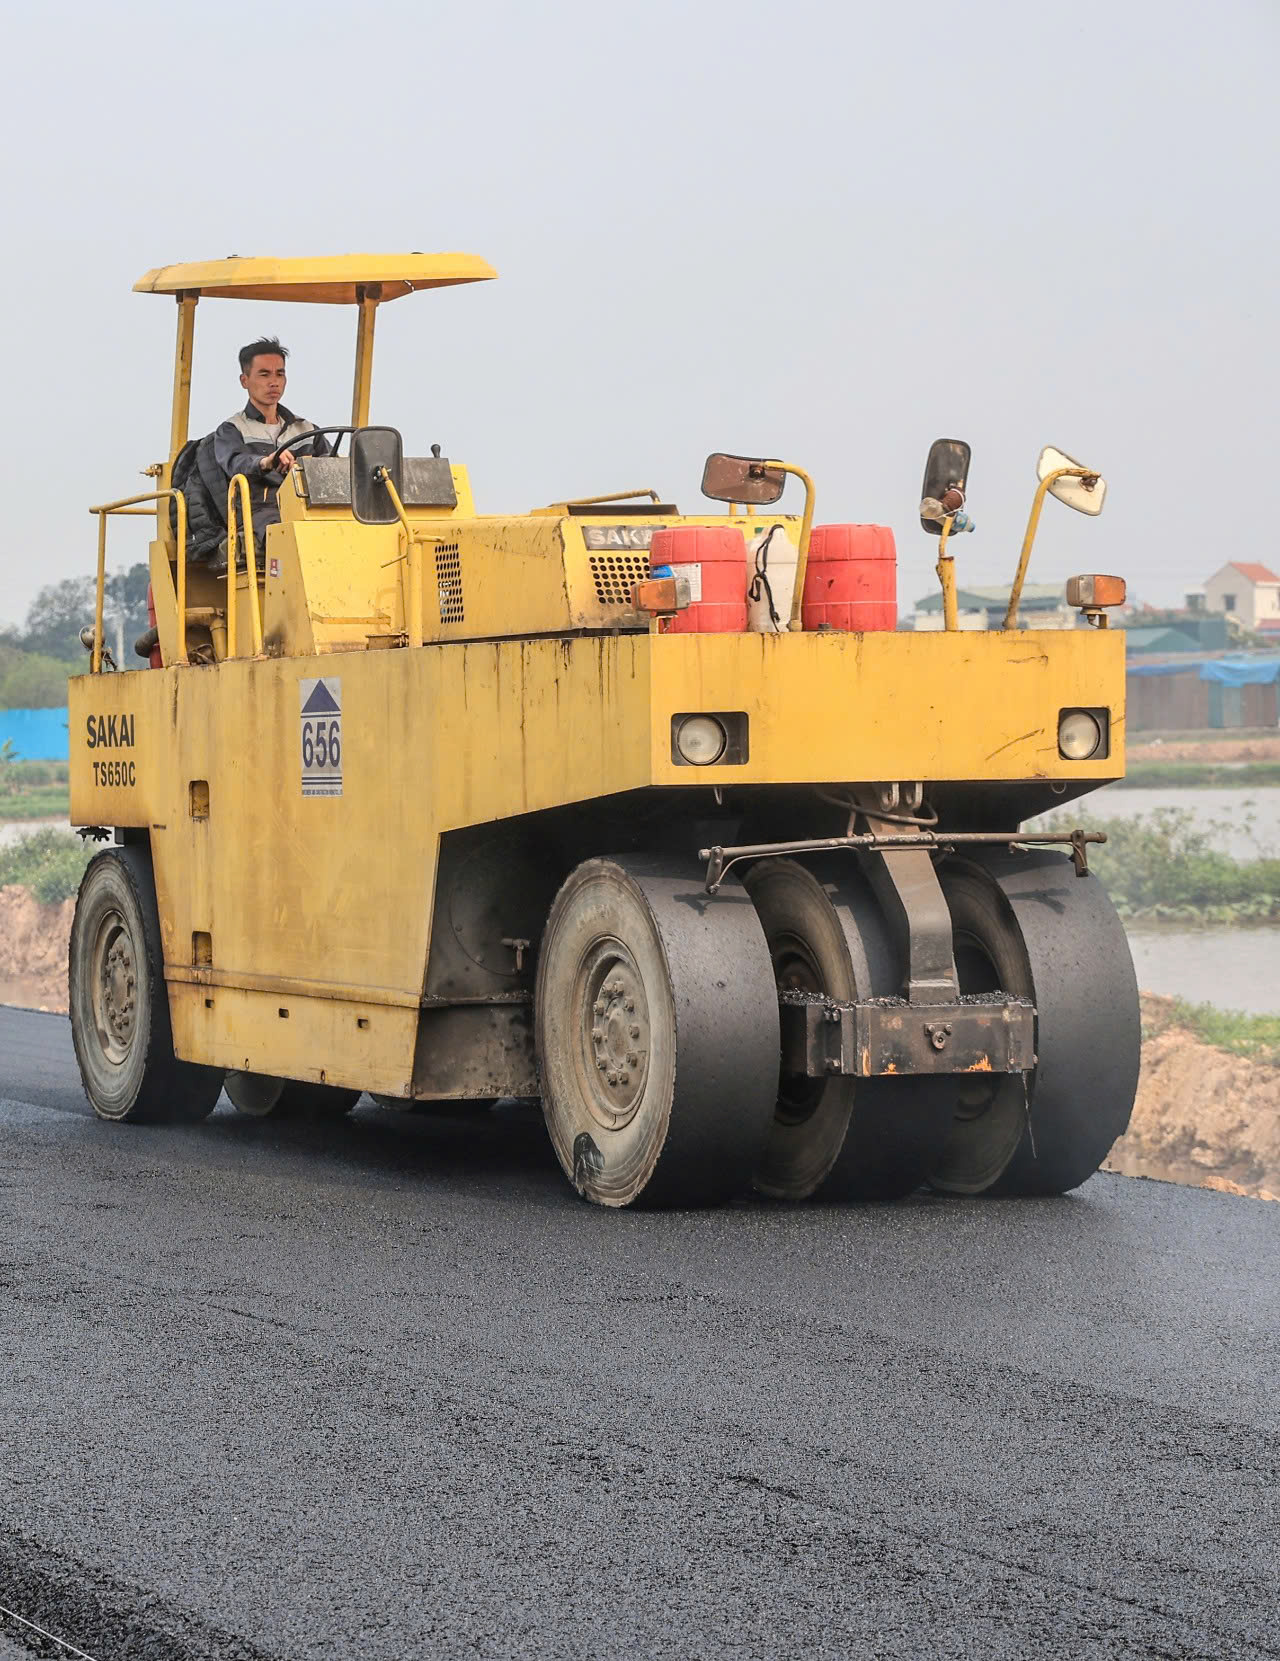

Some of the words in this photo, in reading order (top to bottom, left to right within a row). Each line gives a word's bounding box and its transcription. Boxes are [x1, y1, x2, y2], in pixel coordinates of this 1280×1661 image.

[588, 529, 654, 545] SAKA
[87, 714, 135, 749] SAKAI
[302, 720, 341, 768] 656
[93, 761, 136, 787] TS650C
